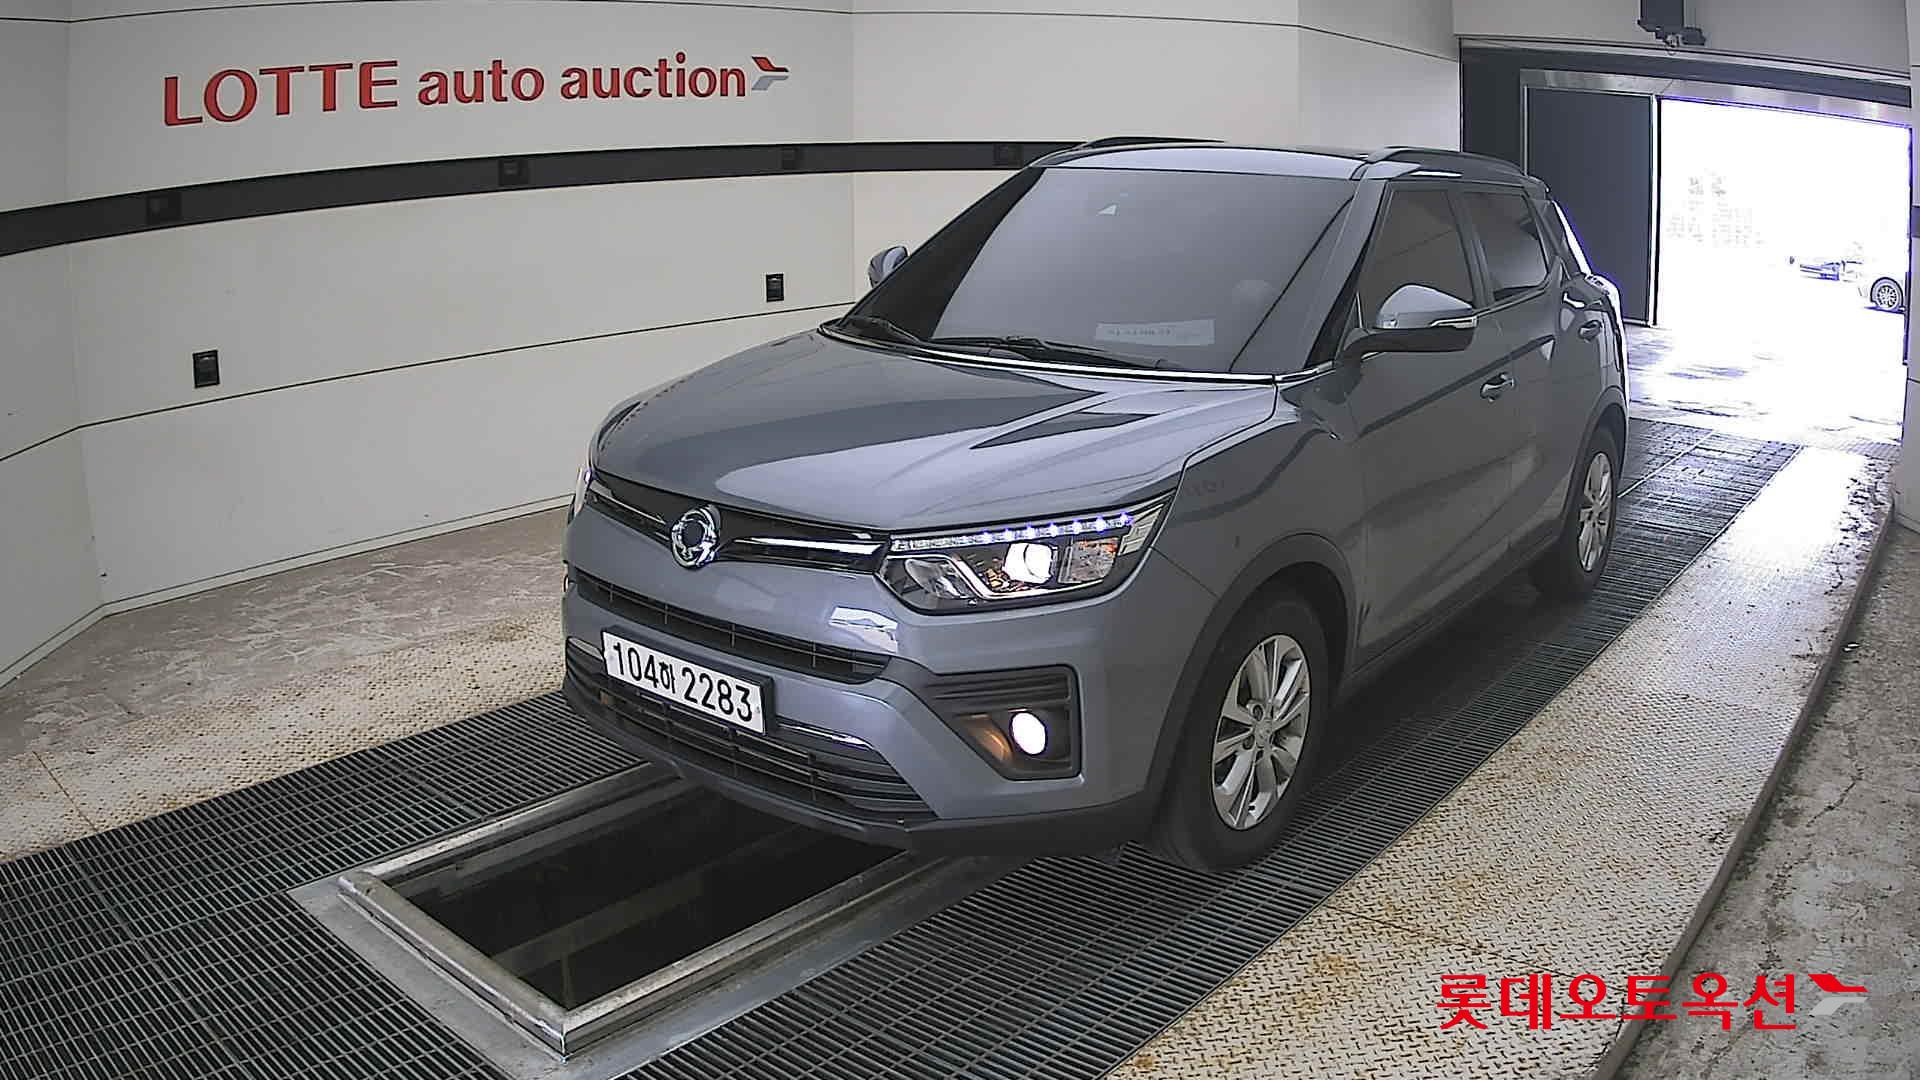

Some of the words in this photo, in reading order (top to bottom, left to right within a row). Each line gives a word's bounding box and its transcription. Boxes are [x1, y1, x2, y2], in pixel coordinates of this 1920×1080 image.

[164, 60, 398, 126] LOTTE
[417, 58, 545, 106] auto
[560, 52, 747, 99] auction
